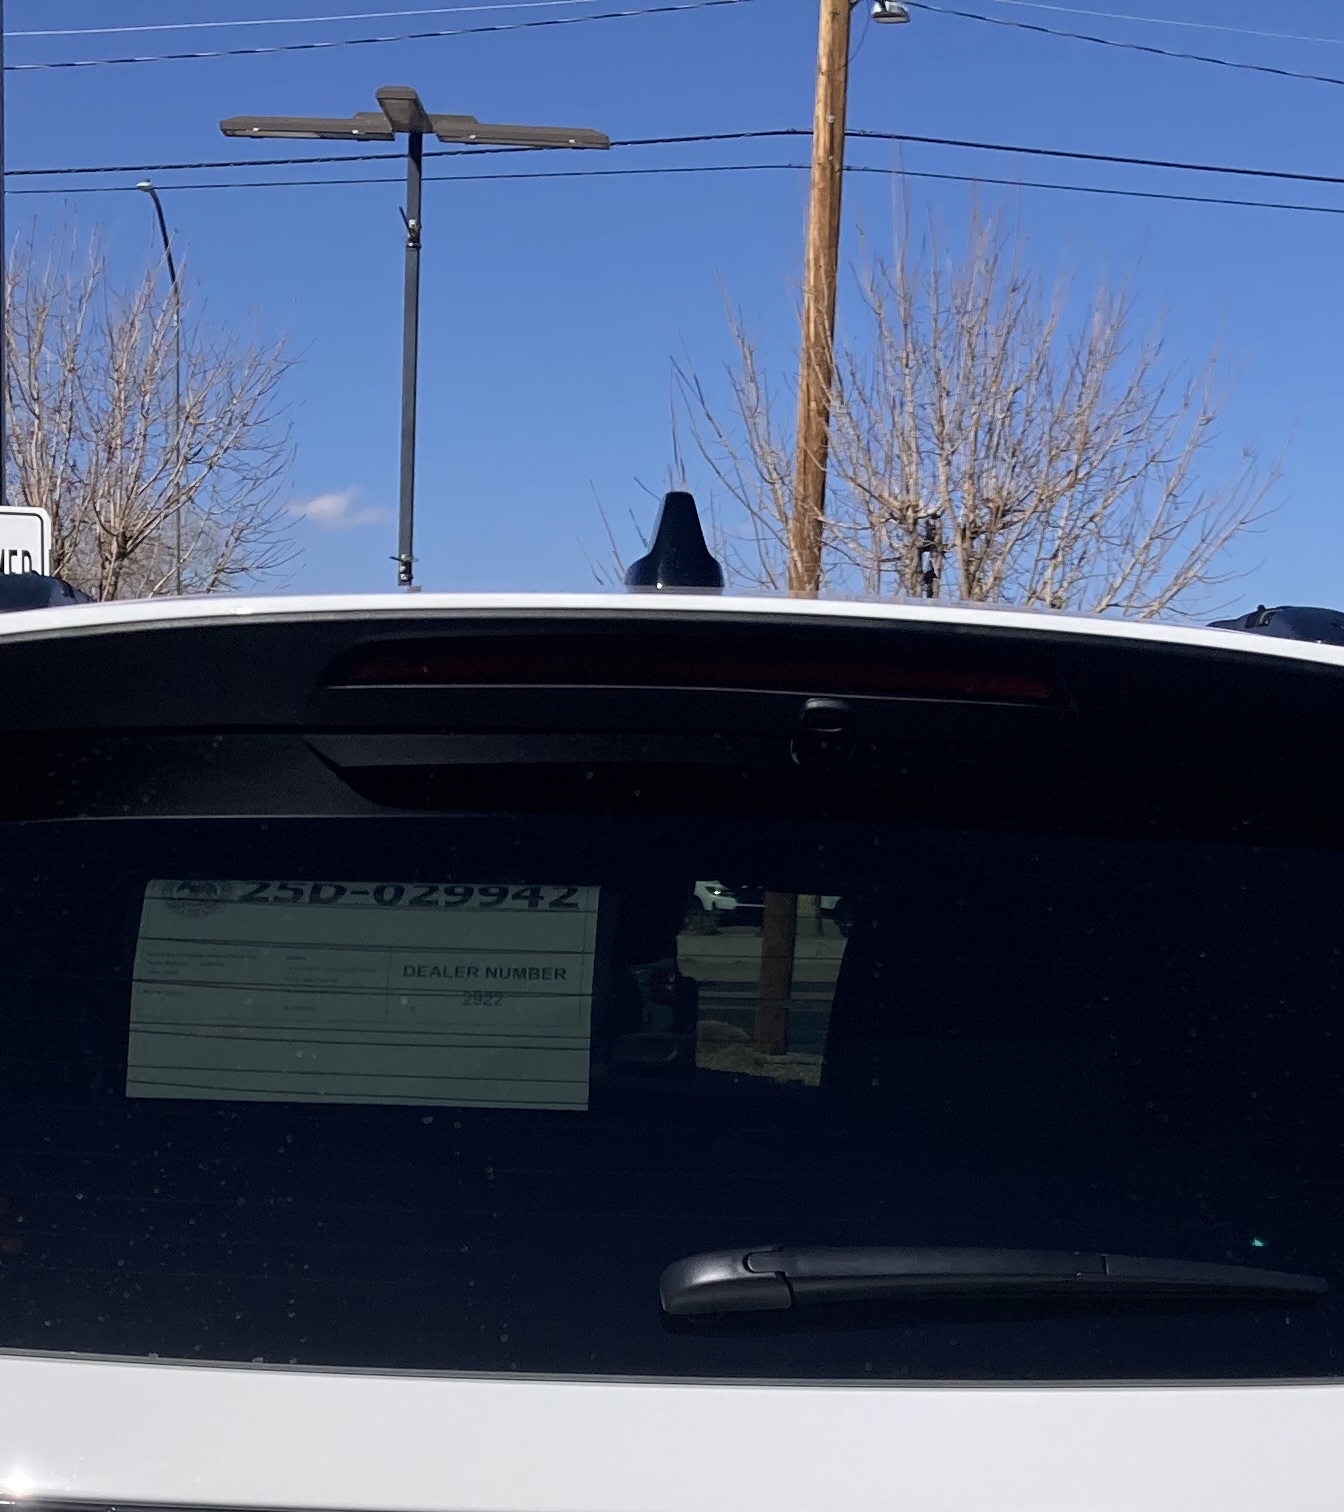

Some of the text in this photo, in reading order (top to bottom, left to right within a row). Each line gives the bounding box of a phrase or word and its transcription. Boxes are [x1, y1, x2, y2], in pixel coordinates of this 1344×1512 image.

[237, 881, 581, 909] 25D-029942
[402, 964, 567, 981] DEALER NUMBER
